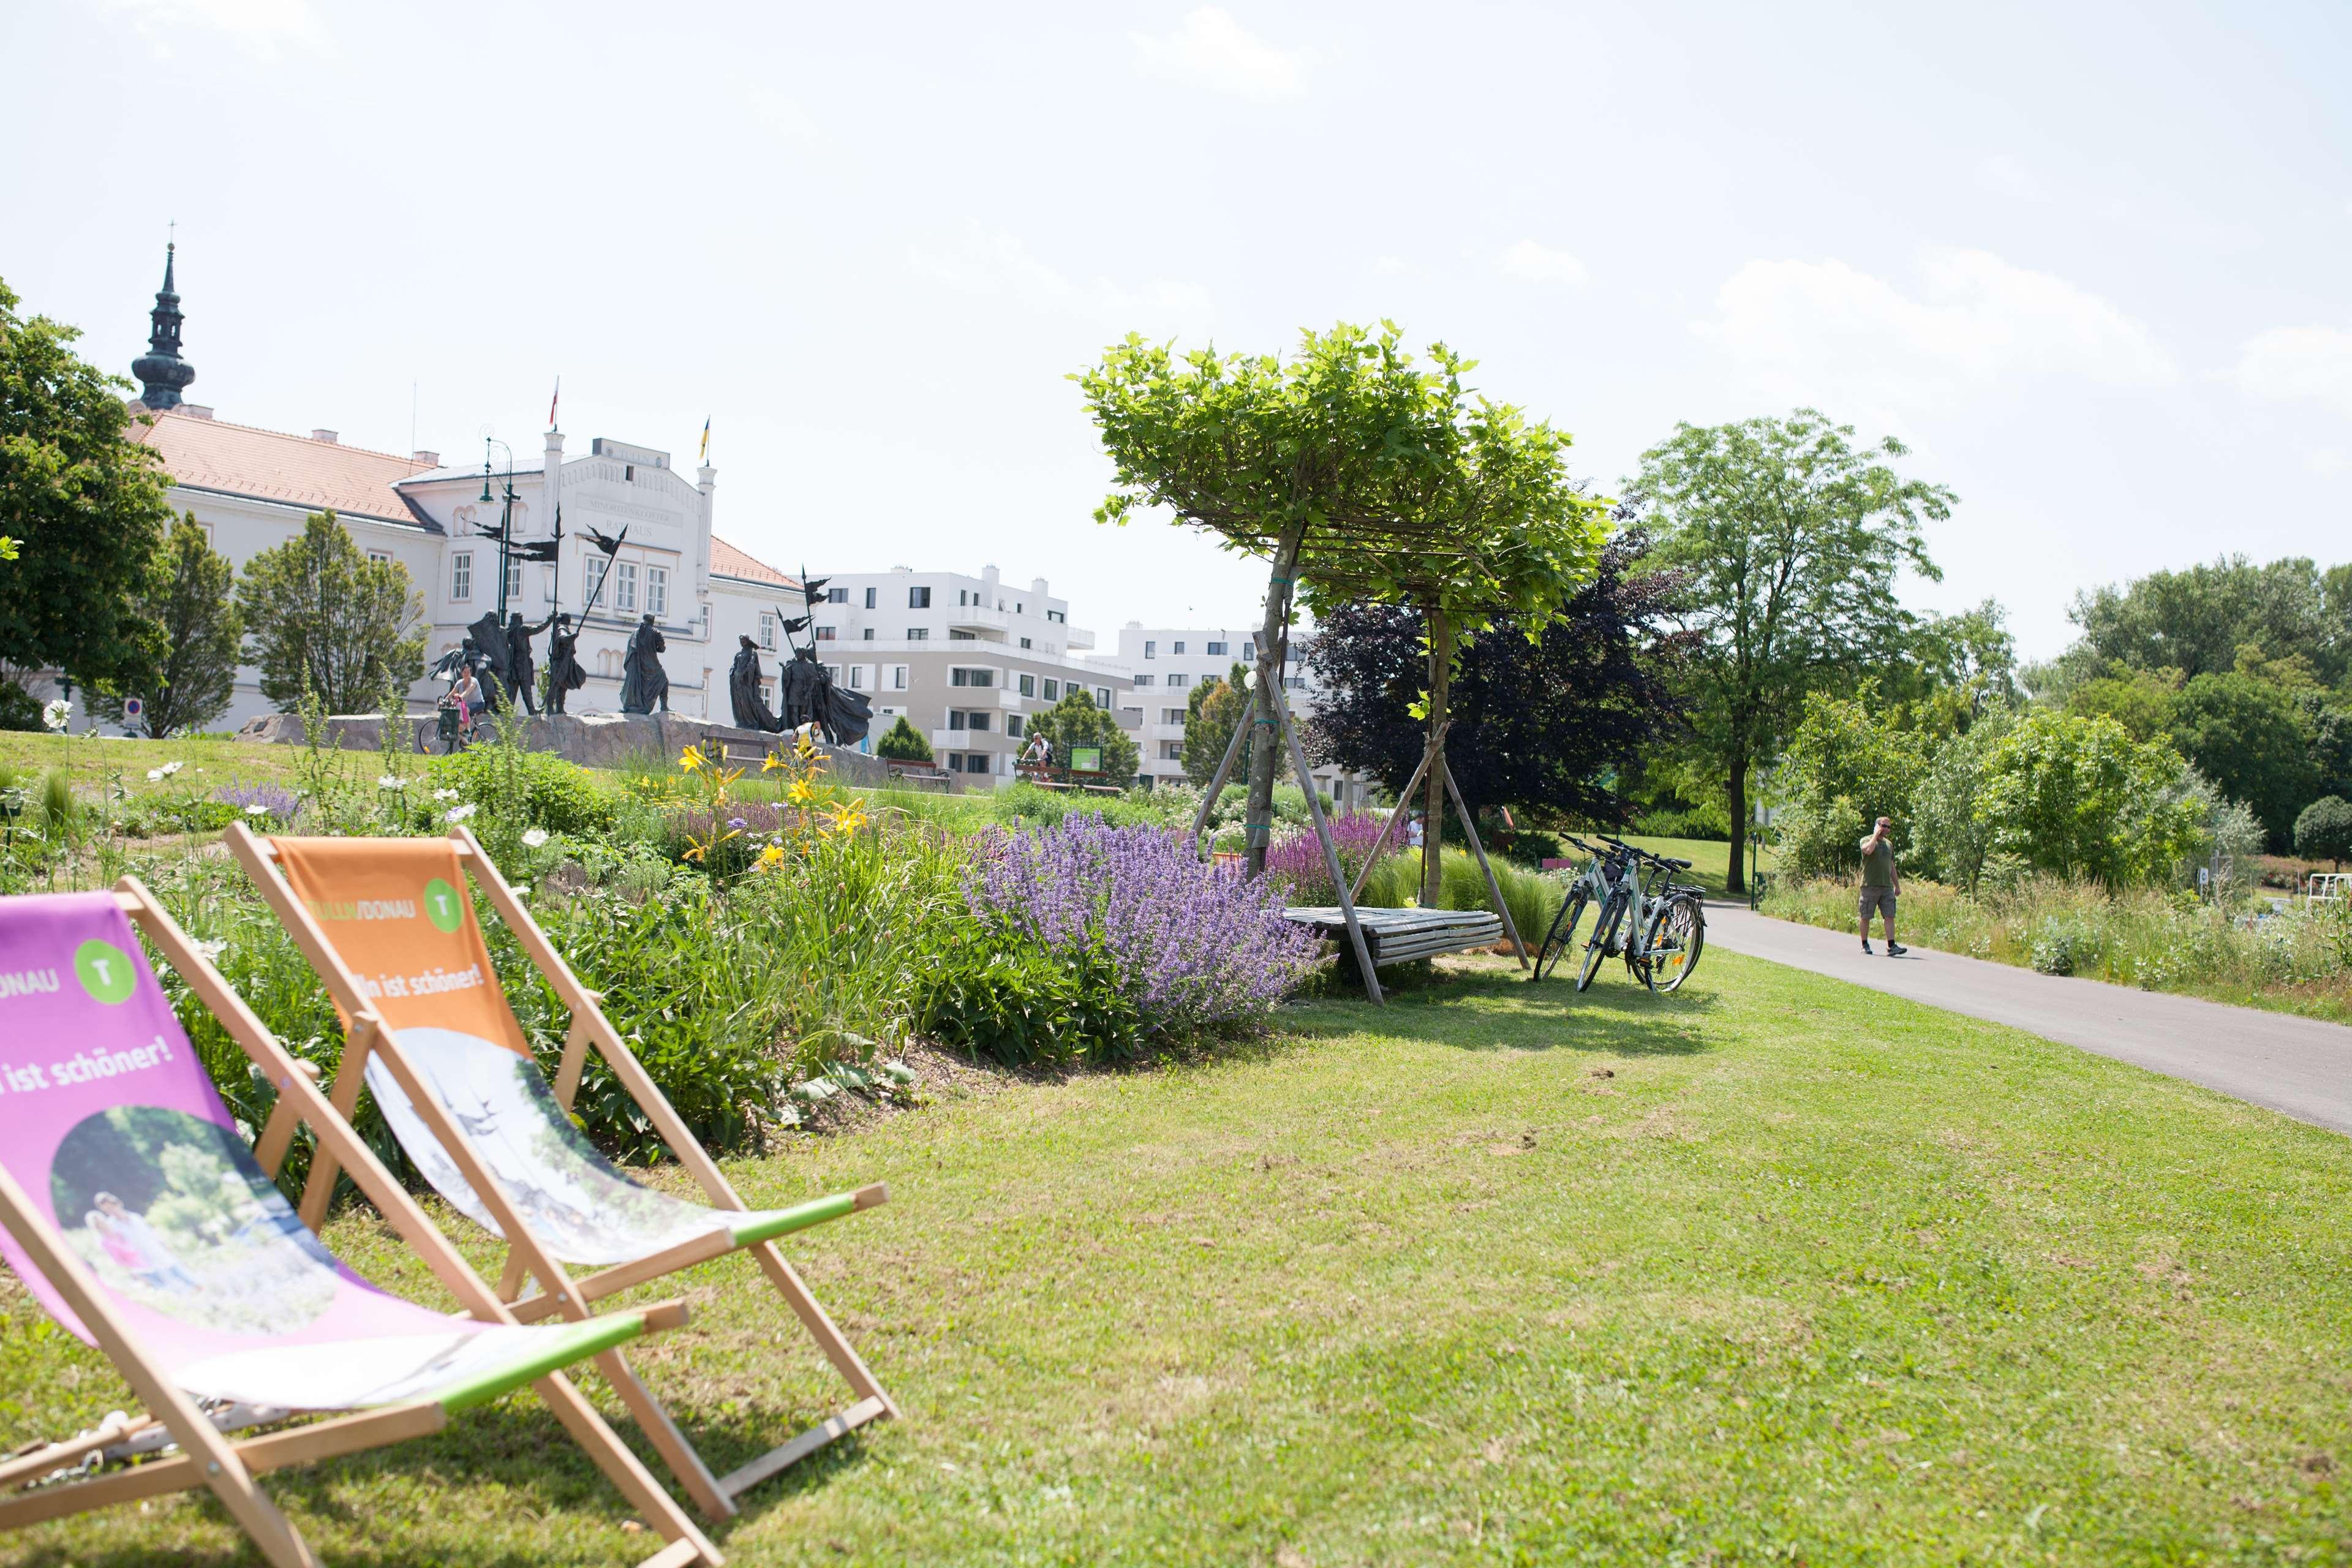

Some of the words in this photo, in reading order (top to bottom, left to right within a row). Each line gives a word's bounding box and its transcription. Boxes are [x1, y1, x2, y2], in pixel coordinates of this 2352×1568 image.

[434, 894, 448, 916] T
[91, 959, 111, 986] T
[379, 973, 410, 998] ist
[409, 962, 485, 995] schöner!
[1, 1061, 50, 1093] ist
[50, 1035, 174, 1086] schöner!
